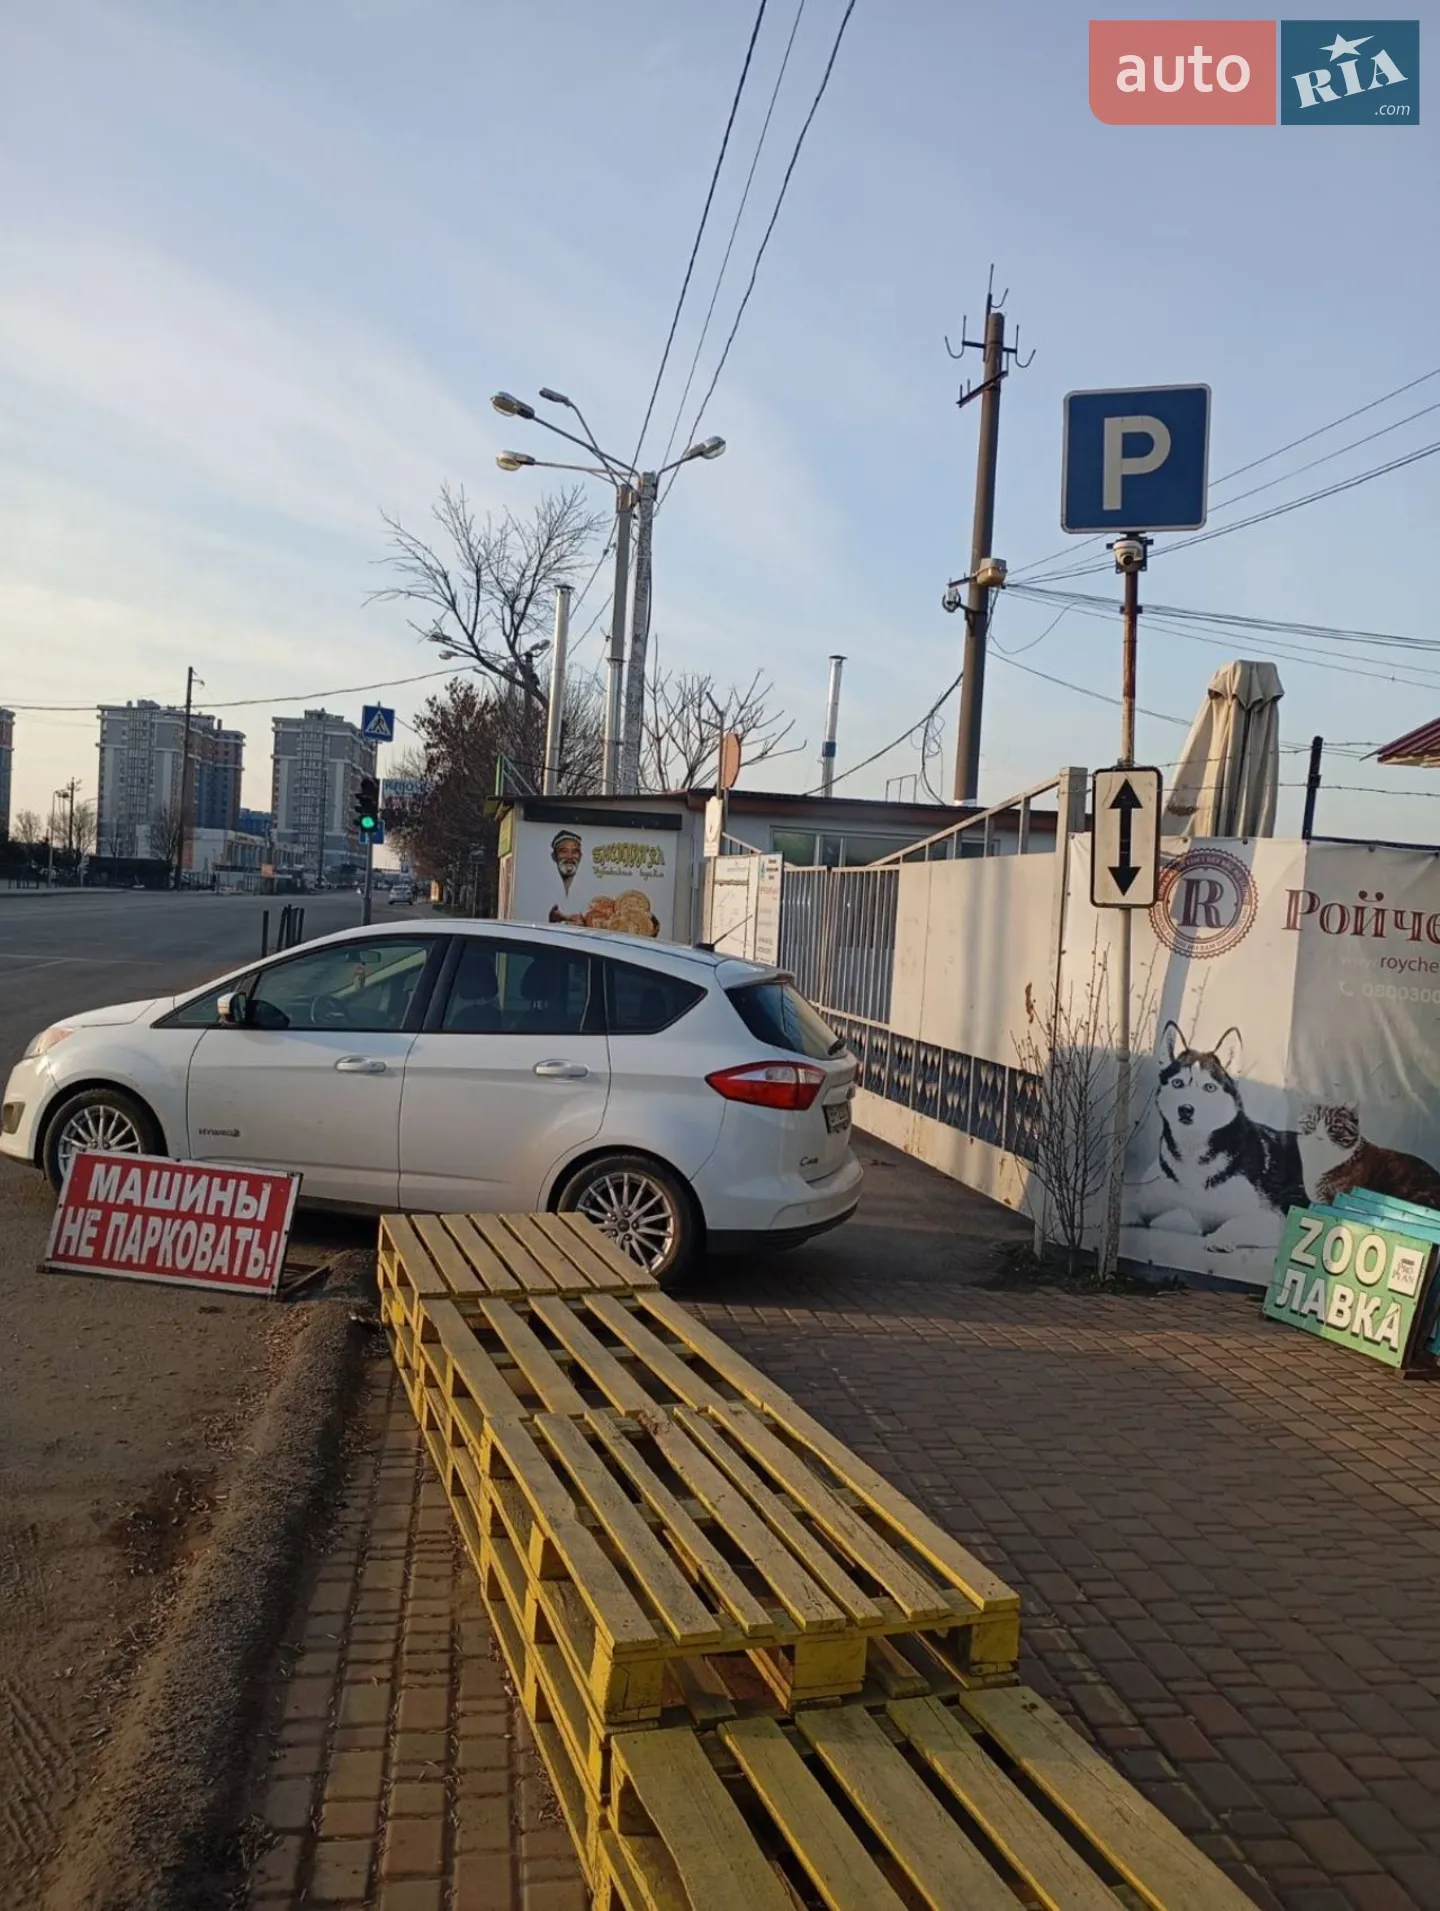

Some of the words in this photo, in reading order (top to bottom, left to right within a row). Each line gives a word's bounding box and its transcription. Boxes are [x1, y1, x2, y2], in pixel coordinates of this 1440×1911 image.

[1102, 414, 1172, 511] P
[87, 1162, 272, 1221] МАШИНЫ
[57, 1206, 104, 1258] НЕ
[101, 1211, 279, 1280] ПАРКОВАТЬ!
[1290, 1216, 1387, 1286] ZOO
[1275, 1268, 1402, 1351] ЛАВКА
